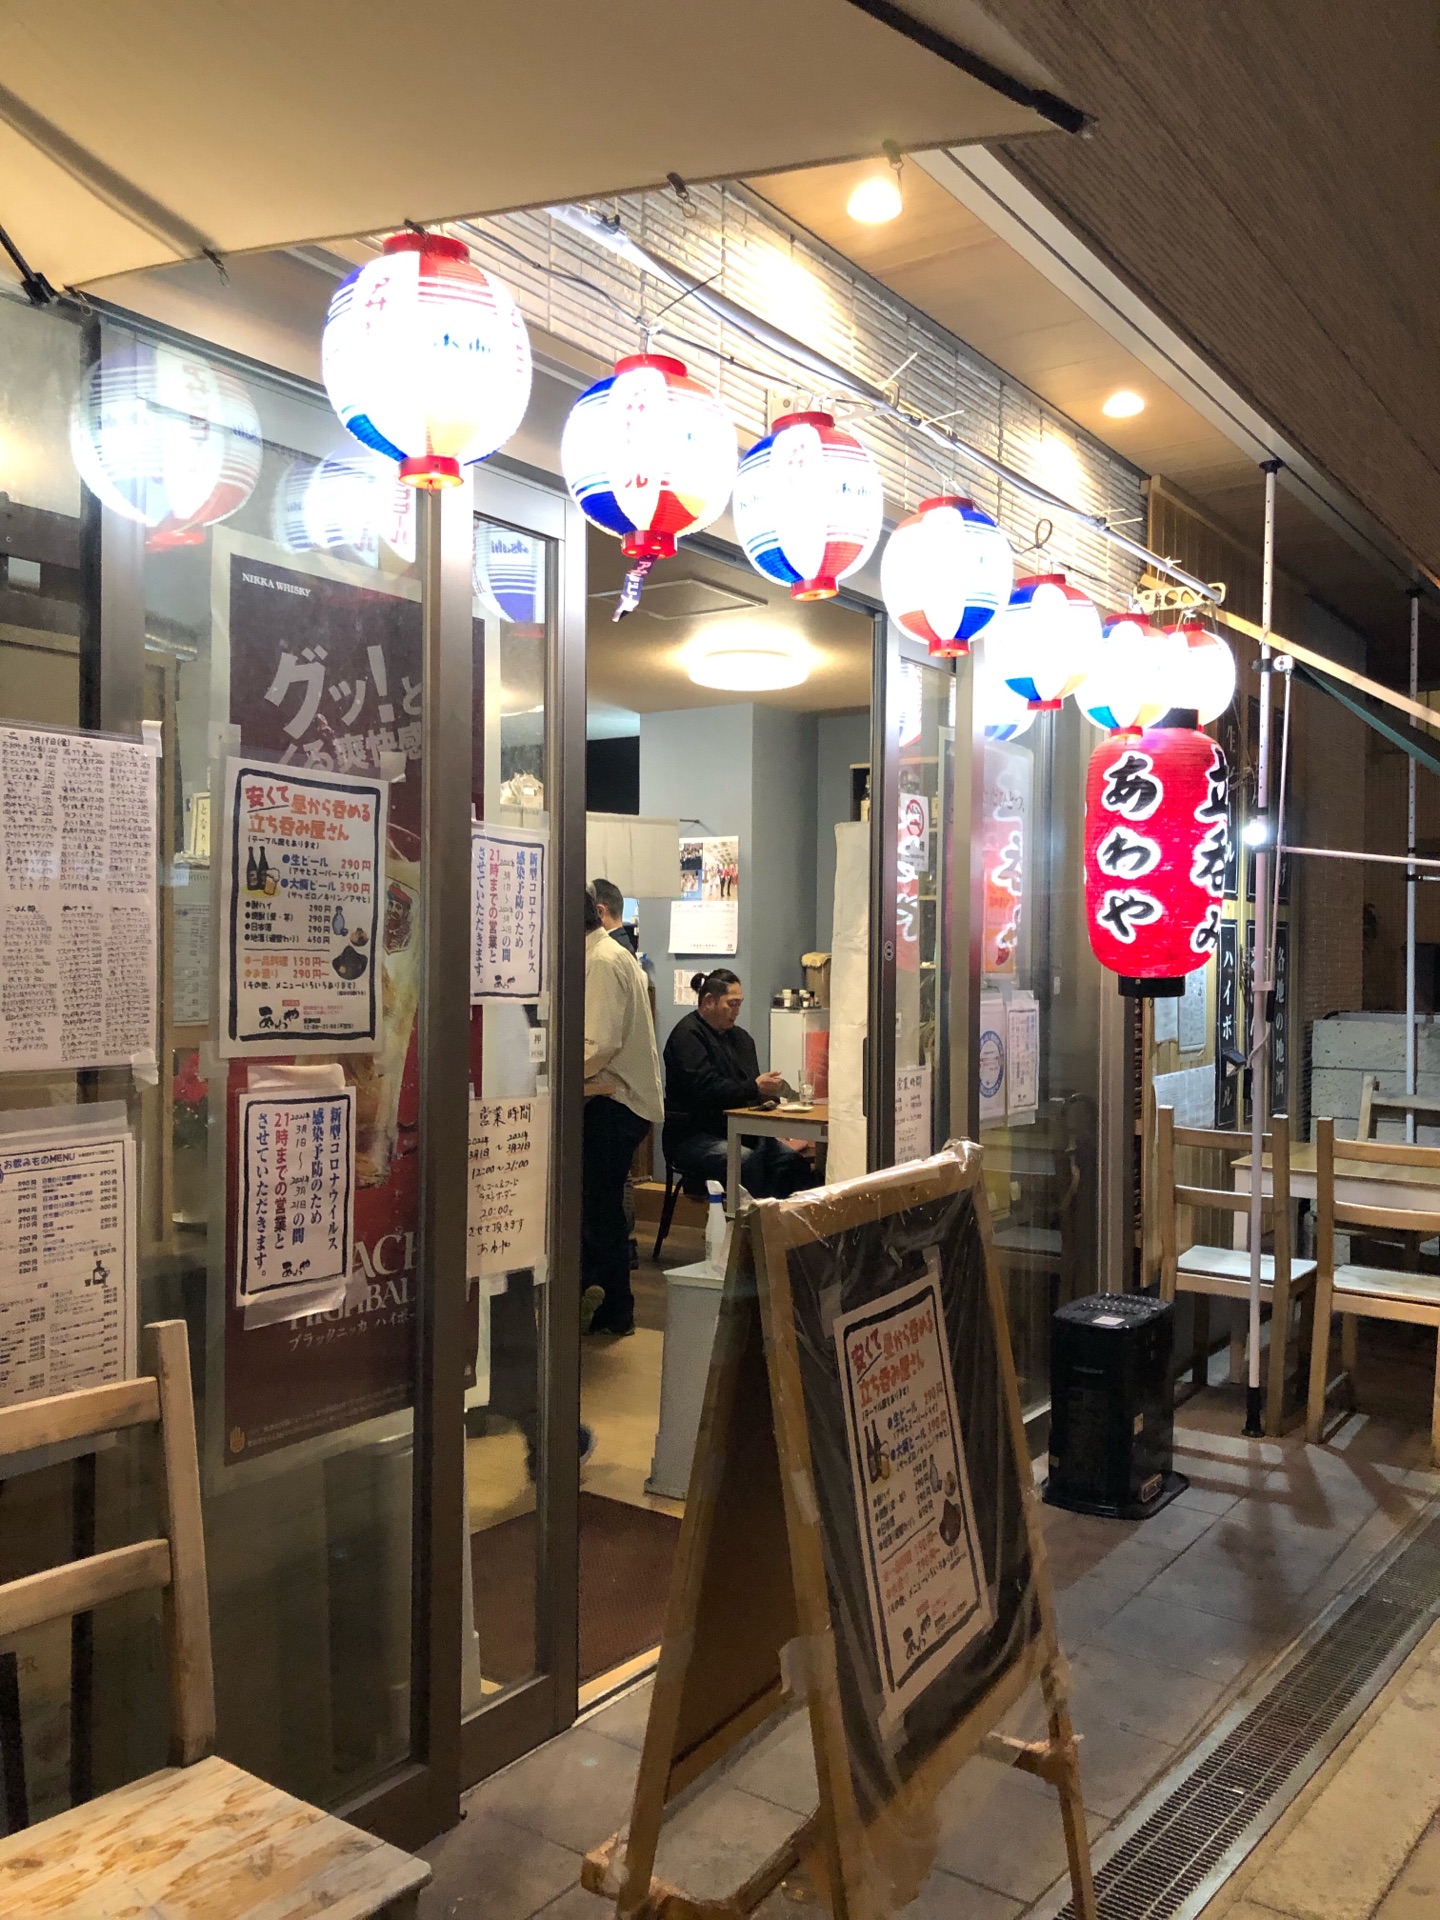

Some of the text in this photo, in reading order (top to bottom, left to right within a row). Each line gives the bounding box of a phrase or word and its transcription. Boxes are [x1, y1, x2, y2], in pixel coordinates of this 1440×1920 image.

[242, 572, 311, 598] NIKKA WHISKY
[248, 813, 349, 840] 立ち呑み屋さん
[1103, 755, 1158, 938] あわや
[291, 855, 371, 871] 生ビール 290円
[340, 882, 370, 894] 390円
[514, 850, 526, 949] 感染予防のため
[251, 923, 330, 934] 日本酒 290円
[309, 915, 331, 923] 290円
[528, 852, 538, 973] 新型コロナウイルス
[308, 936, 330, 944] 450円
[1223, 952, 1237, 1110] ハイボル
[479, 1104, 532, 1127] 営業時間
[274, 1112, 290, 1250] 21時までの営業と
[310, 1107, 325, 1226] 感染予防のため
[328, 1106, 342, 1251] 新型コロナウイルス
[254, 1113, 269, 1277] させていただきます。
[289, 1318, 368, 1352] ブラックニッカ
[860, 1350, 925, 1408] 立ち呑み屋さん
